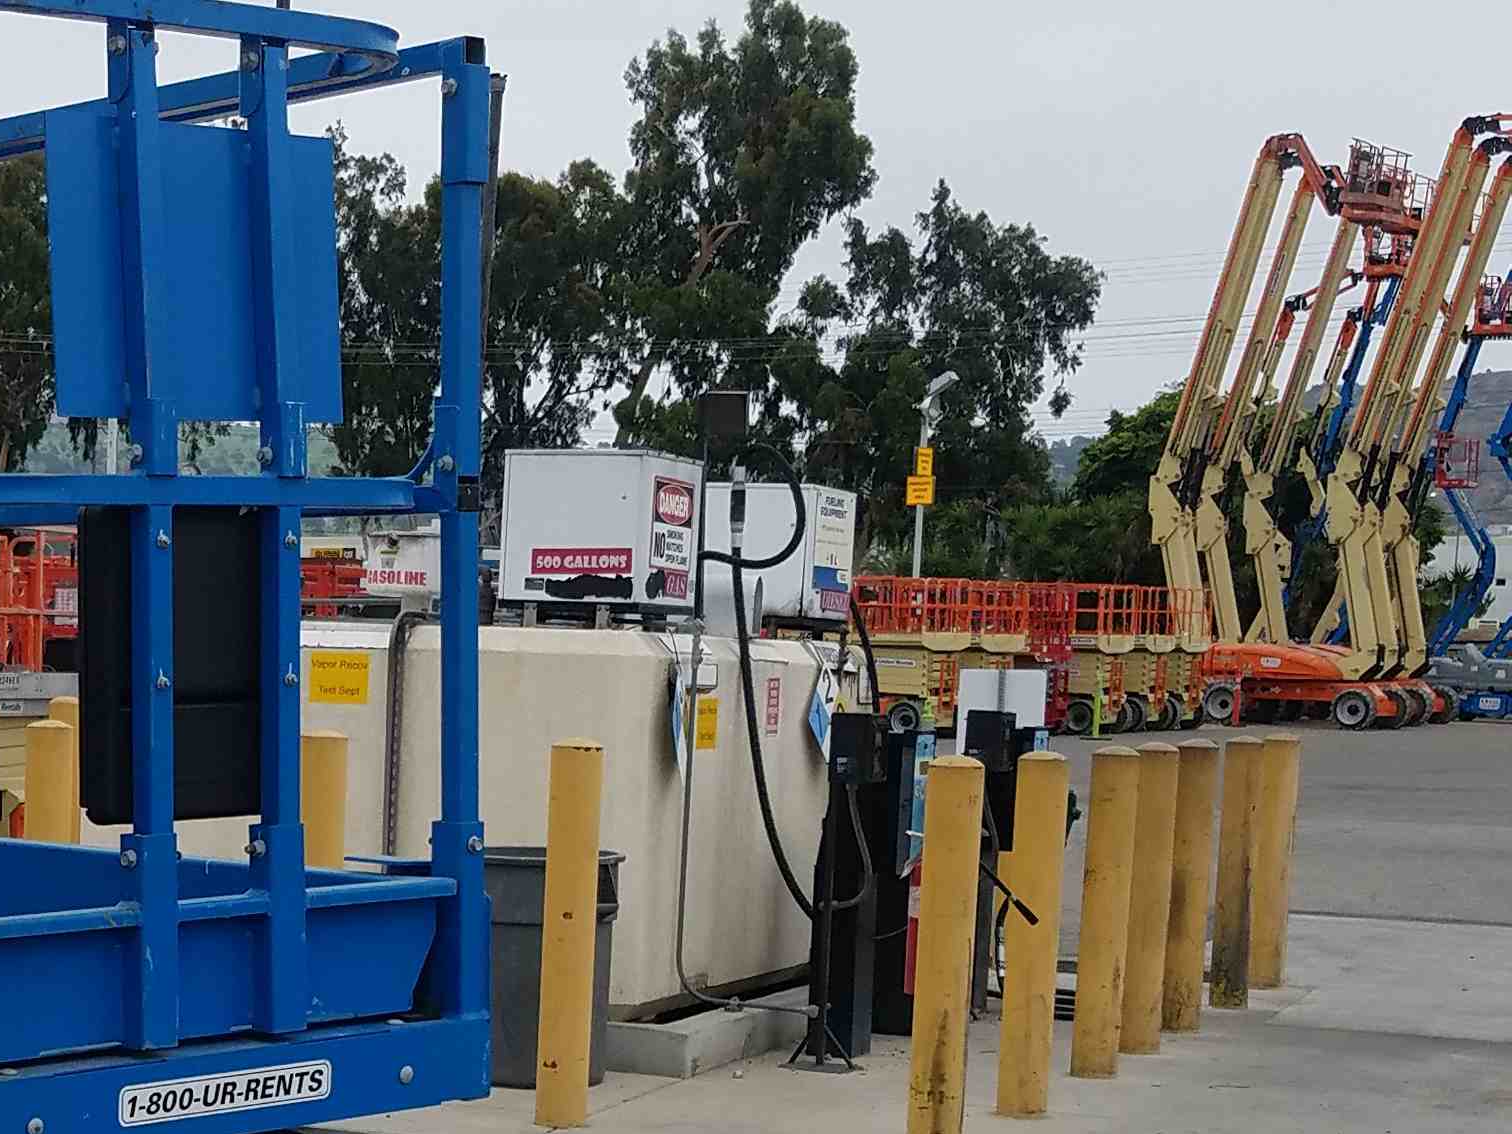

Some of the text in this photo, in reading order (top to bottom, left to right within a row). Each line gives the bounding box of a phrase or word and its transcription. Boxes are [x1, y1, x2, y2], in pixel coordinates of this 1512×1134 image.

[659, 492, 690, 517] DANGER
[654, 531, 666, 559] NO
[535, 554, 627, 569] 500 GALLONS
[127, 1069, 324, 1118] 1-800-UR-RENTS
